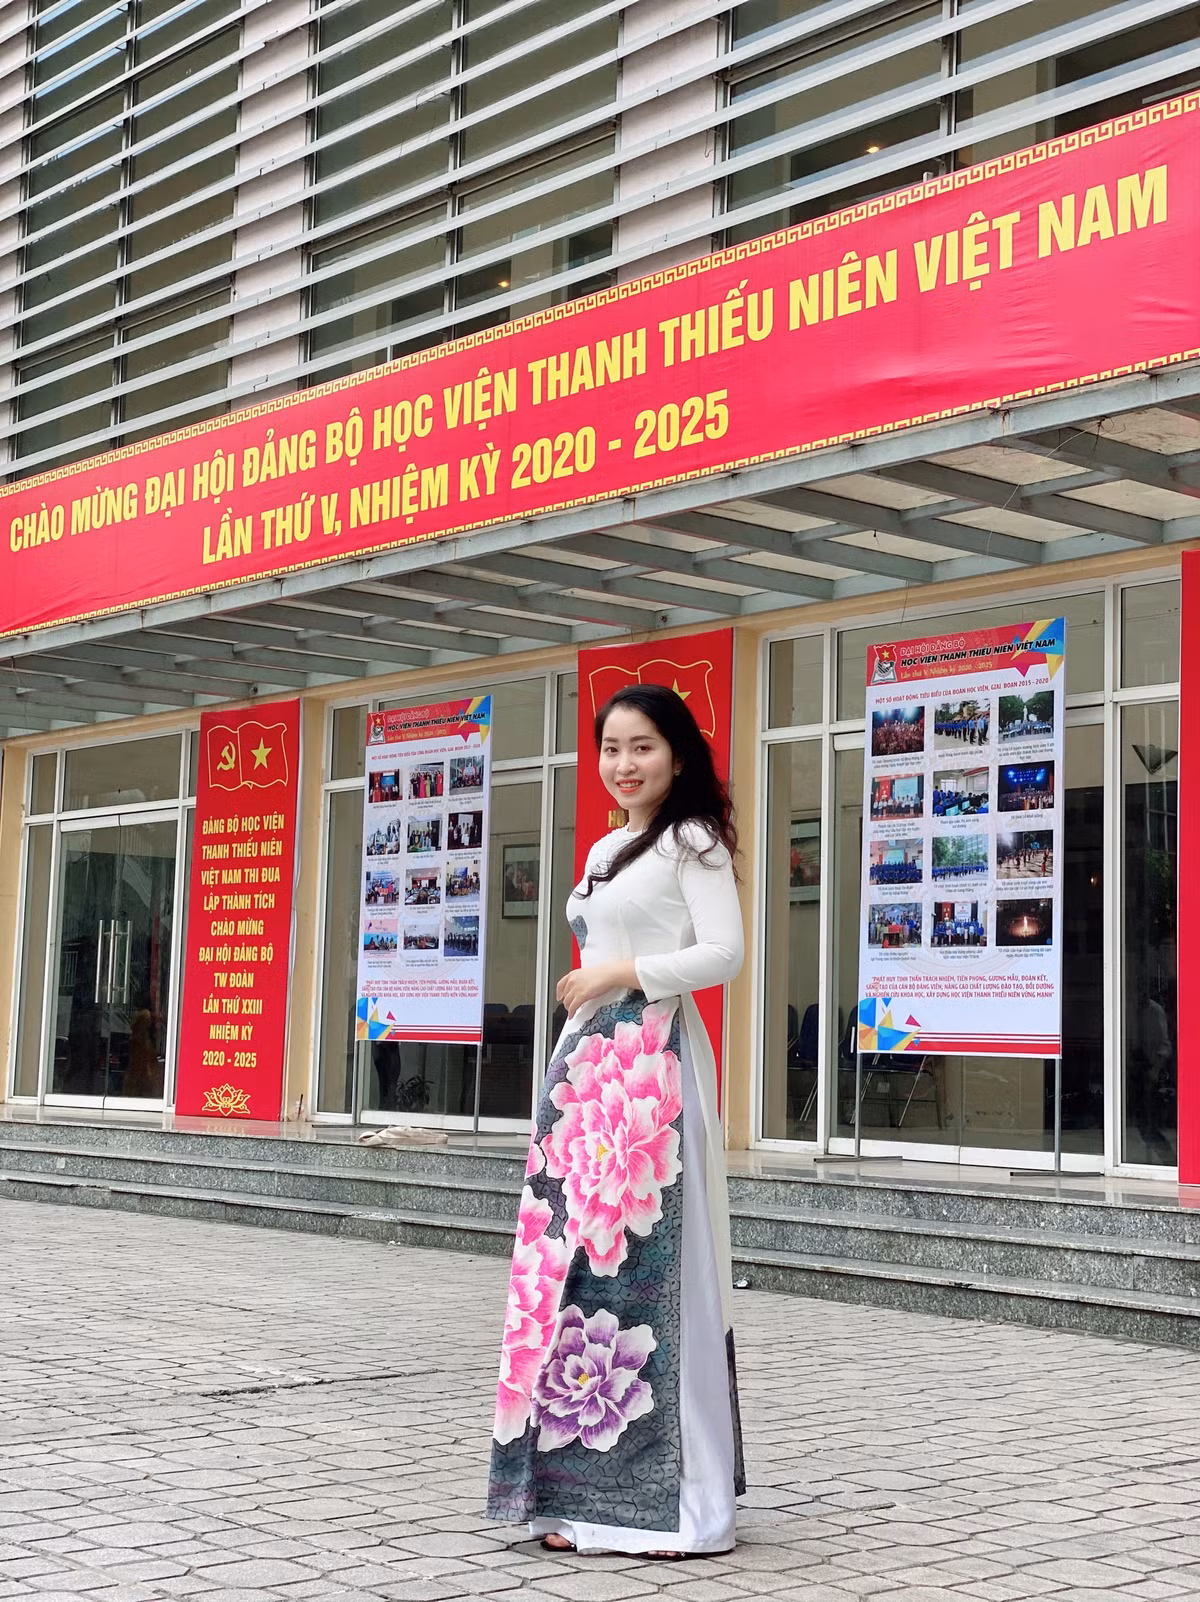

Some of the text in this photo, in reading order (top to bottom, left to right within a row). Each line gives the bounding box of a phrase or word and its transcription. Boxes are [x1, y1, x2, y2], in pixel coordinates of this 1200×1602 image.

[10, 166, 1167, 552] CHÀO MỪNG ĐẠI HỘI ĐẢNG BỘ HỌC VIỆN THANH THIẾU NIÊN VIỆT NAM
[203, 512, 252, 564] LẦN
[261, 493, 315, 549] THỨ
[321, 493, 341, 535] V,
[350, 463, 448, 528] NHIỆM
[460, 442, 501, 501] KỲ
[512, 427, 595, 489] 2020
[634, 389, 728, 458] 2025
[901, 638, 1055, 669] HỌC VIỆN THANH THIẾU NIÊN VIỆT NAM
[1036, 677, 1049, 685] 2020
[202, 811, 284, 836] ĐẢNG BỘ HỌC VIỆN
[202, 837, 282, 860] THANH THIẾU NIÊN
[201, 866, 280, 888] VIỆT NAM THI ĐUA
[204, 890, 275, 914] LẬP THÀNH TÍCH
[211, 916, 264, 936] CHÀO MỪNG
[199, 942, 273, 965] ĐẠI HỘI ĐẢNG BỘ
[214, 969, 254, 988] TW ĐOÀN
[203, 993, 263, 1015] LẦN THỨ XXIII
[210, 1021, 253, 1044] NHIỆM KỲ
[202, 1050, 225, 1067] 2020
[234, 1051, 257, 1068] 2025
